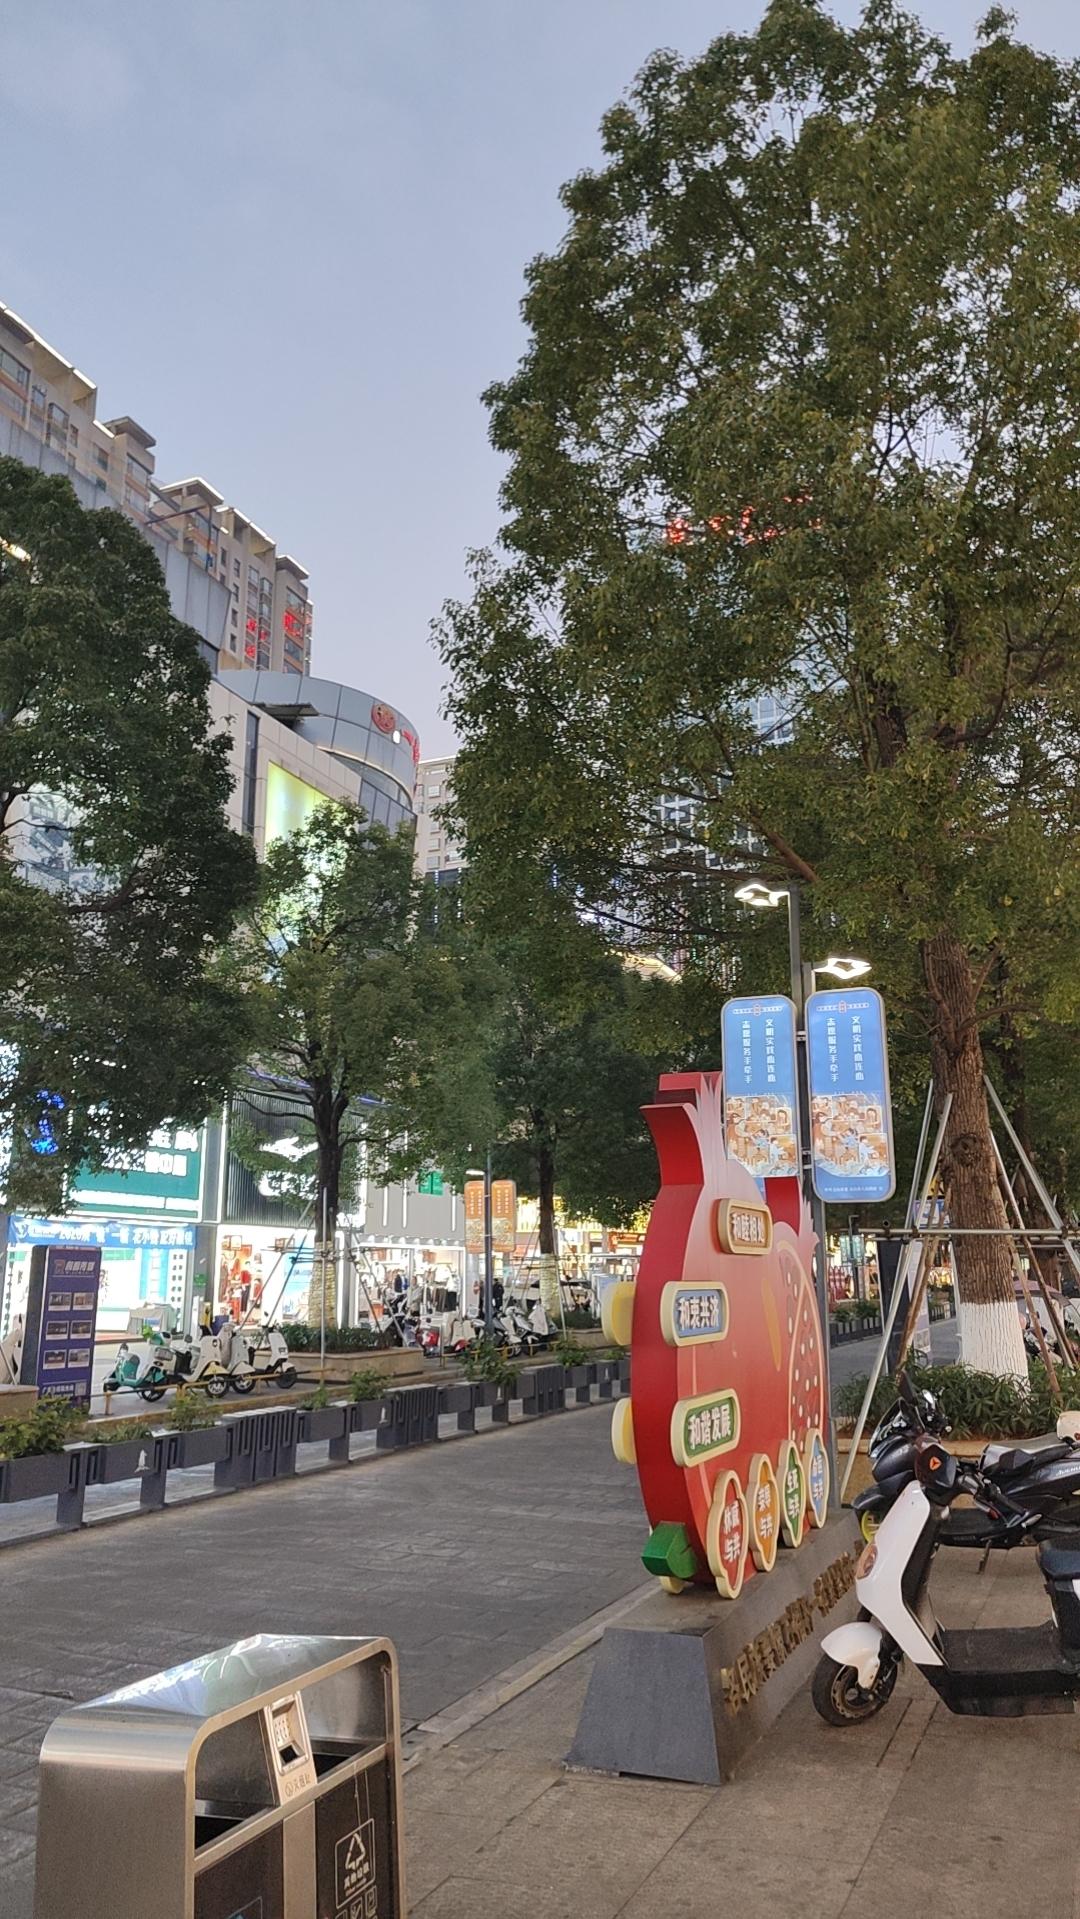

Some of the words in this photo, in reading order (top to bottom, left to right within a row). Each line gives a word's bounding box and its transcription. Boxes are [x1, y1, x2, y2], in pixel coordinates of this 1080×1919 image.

[731, 1211, 765, 1244] 和睦相处
[677, 1295, 719, 1331] 和衷共济
[687, 1404, 732, 1450] 和谐发展
